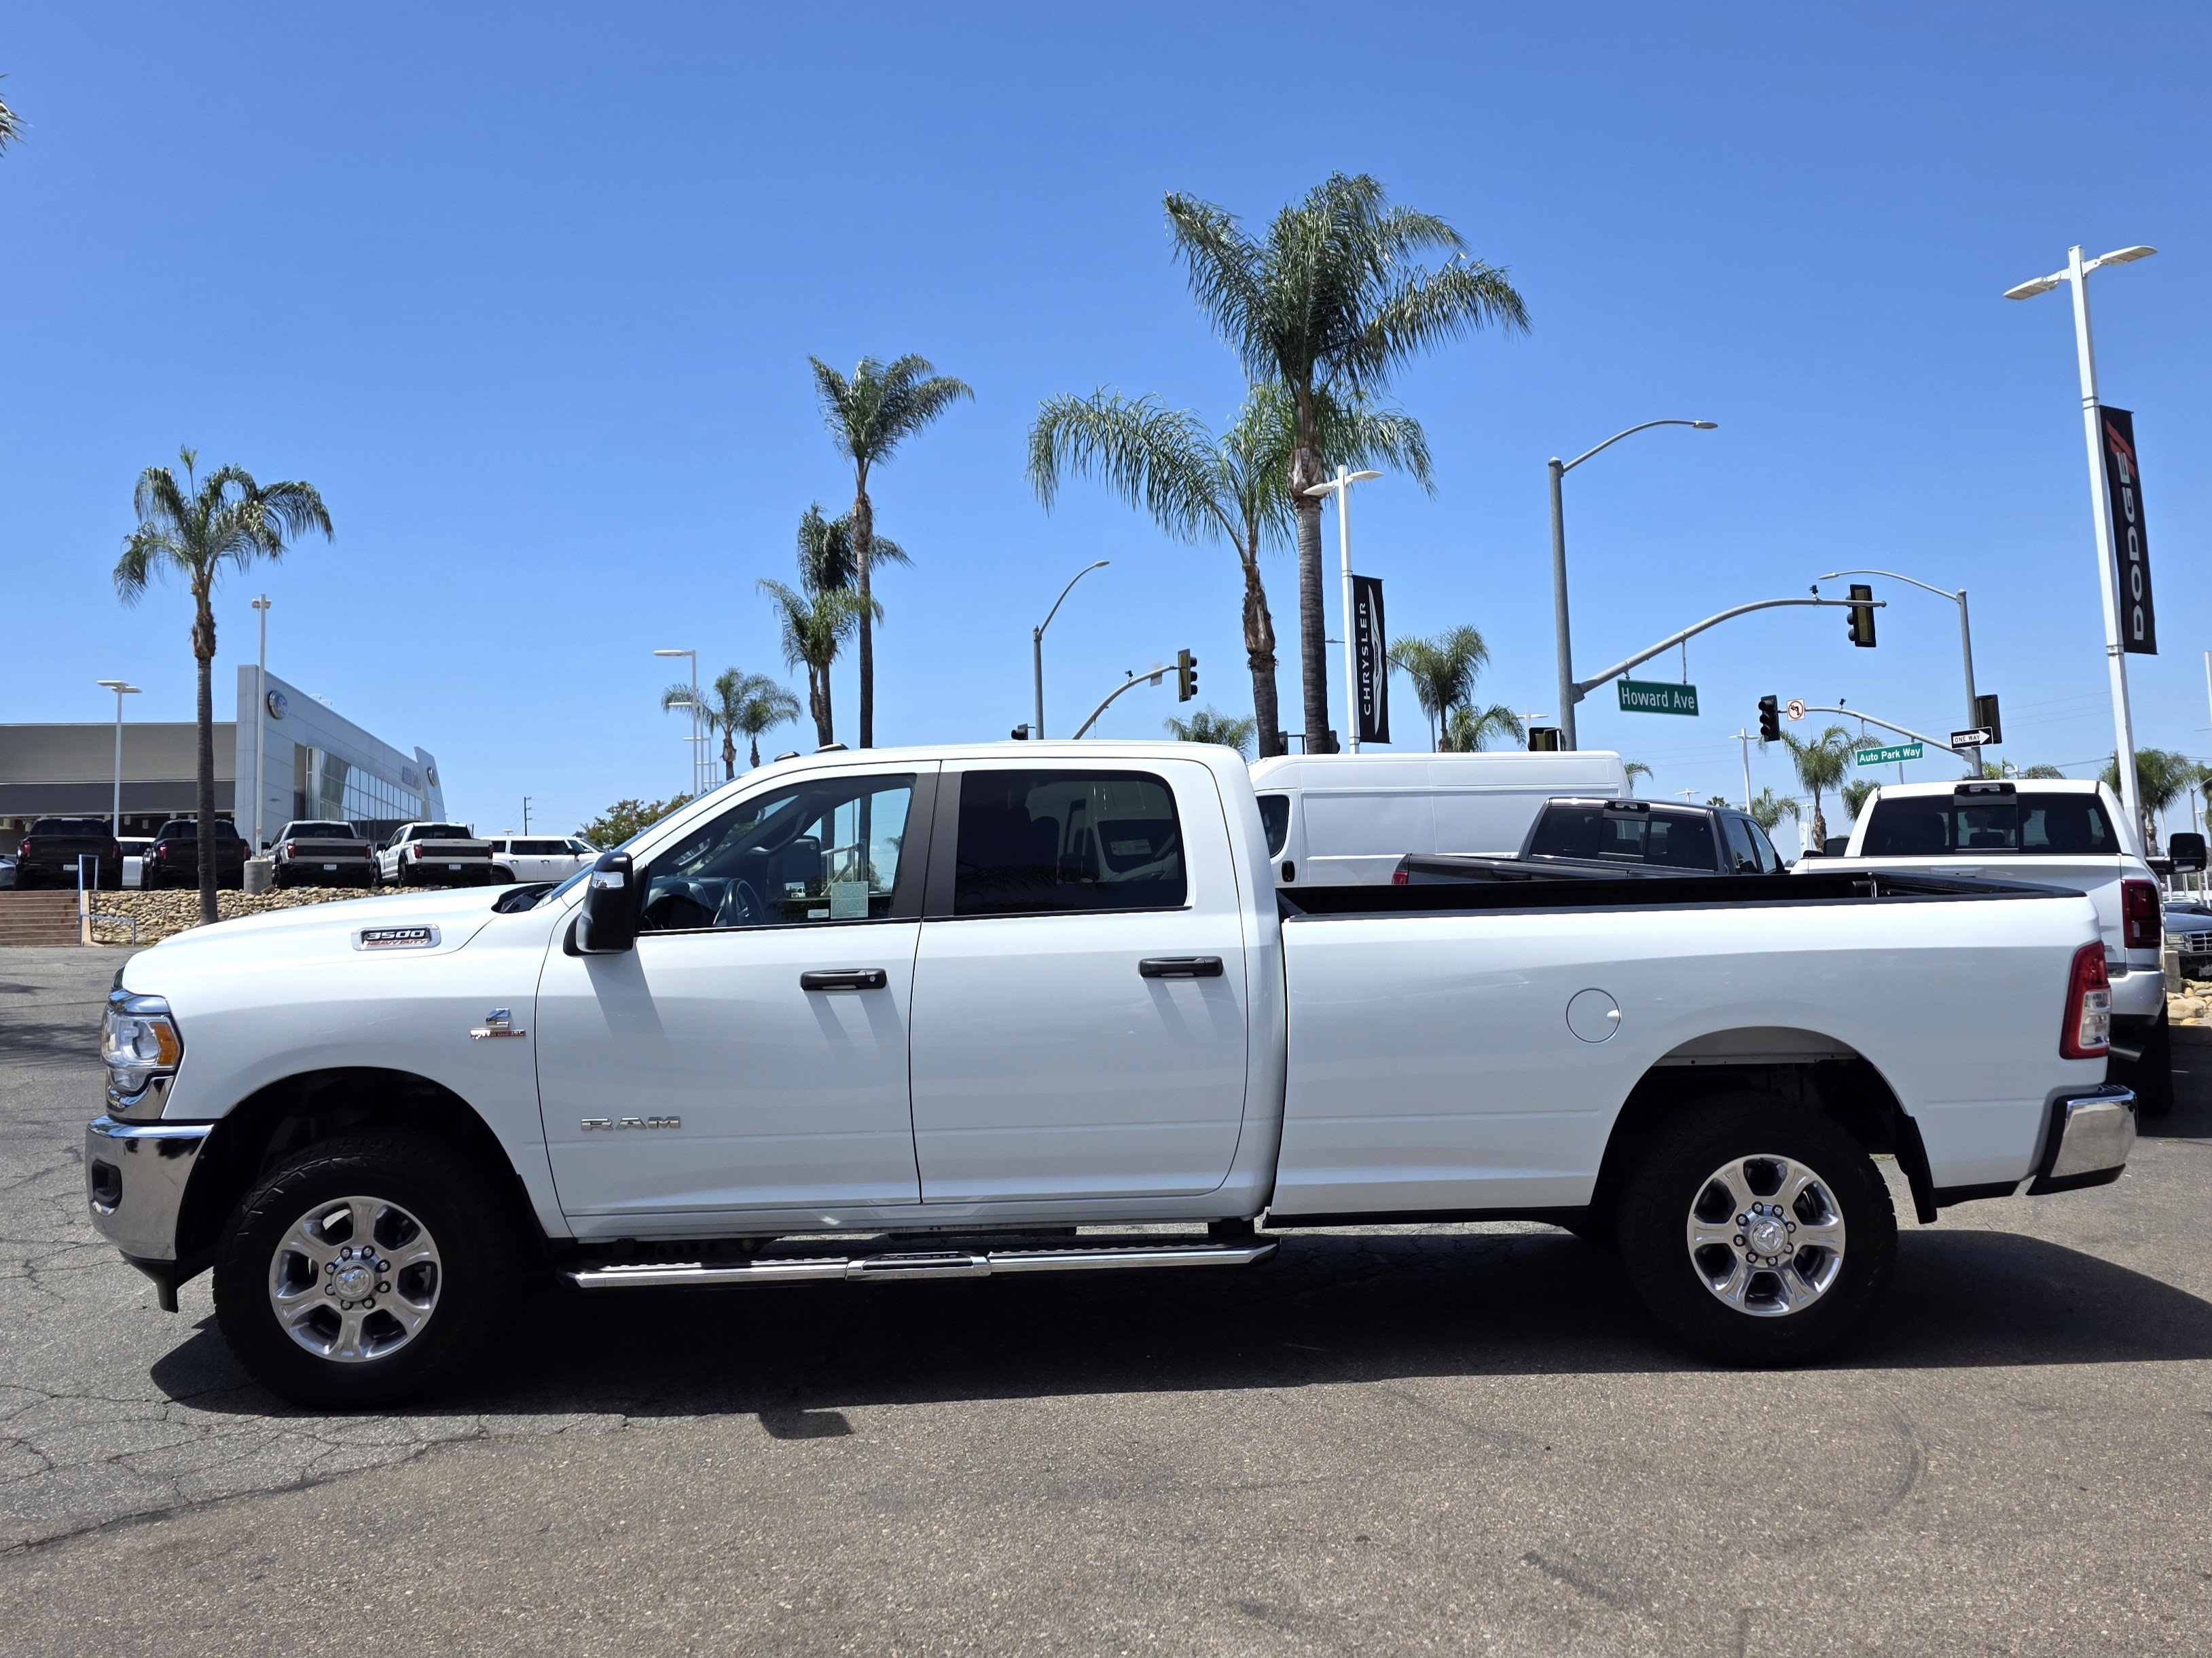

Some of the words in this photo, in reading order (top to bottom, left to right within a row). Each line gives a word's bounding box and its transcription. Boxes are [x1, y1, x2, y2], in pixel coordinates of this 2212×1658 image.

[2116, 452, 2143, 640] DODGE
[1360, 603, 1371, 715] CHRYSLER
[1622, 687, 1669, 707] Howard
[1673, 691, 1694, 709] Ave
[1859, 754, 1879, 762] Auto
[1881, 751, 1900, 760] Park
[1903, 748, 1921, 758] Way
[367, 929, 425, 940] 3500
[581, 1116, 681, 1130] RAM
